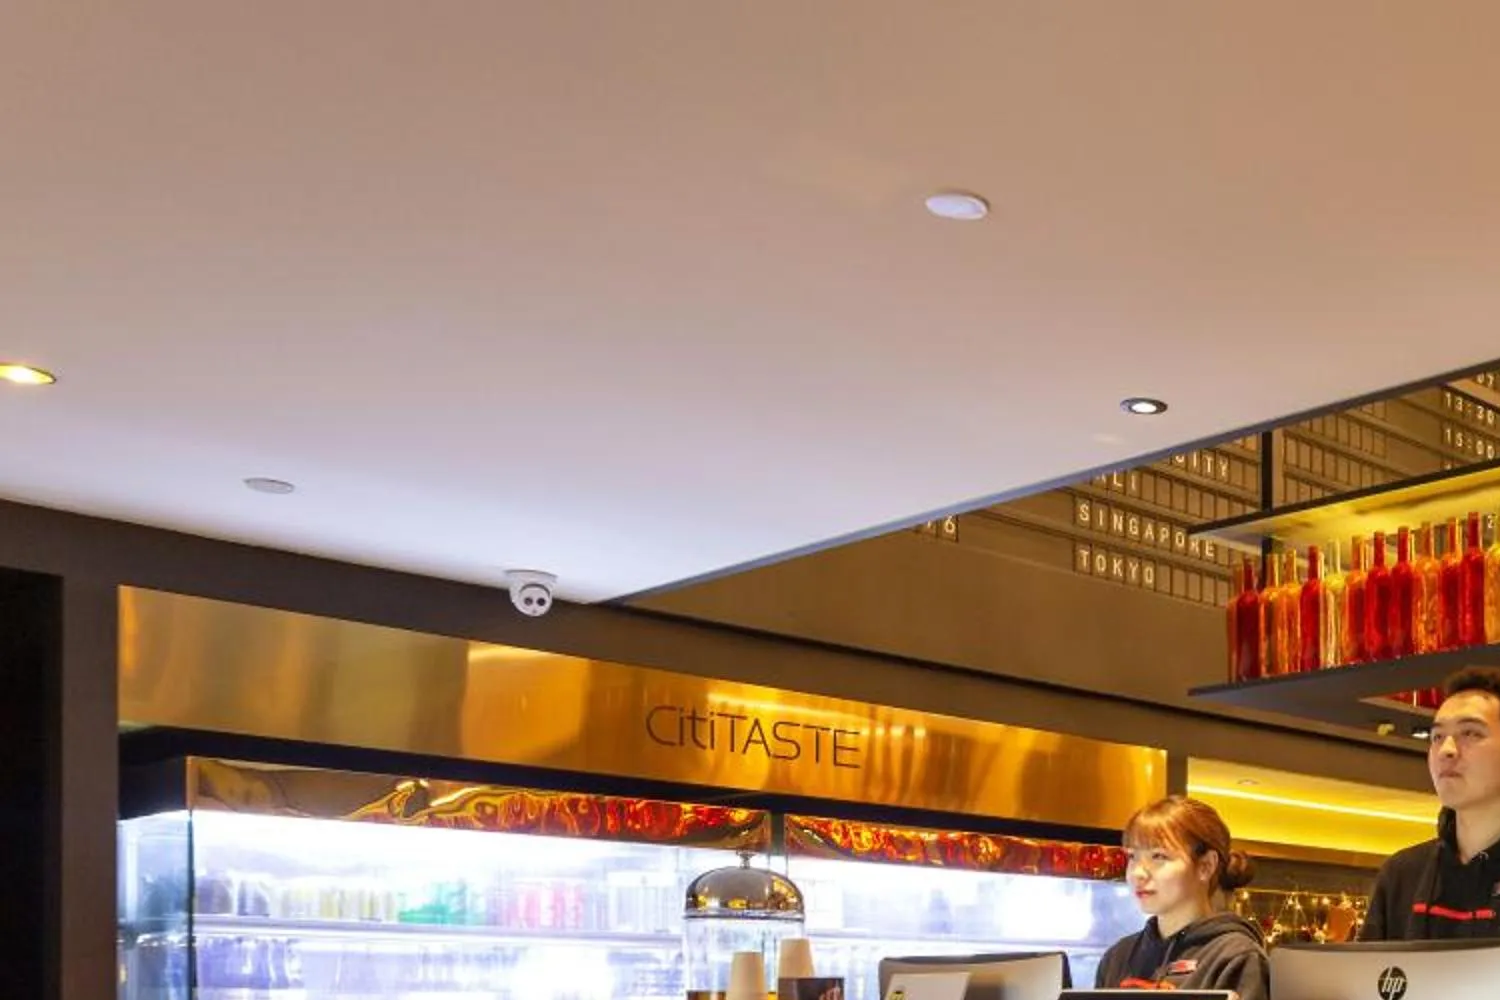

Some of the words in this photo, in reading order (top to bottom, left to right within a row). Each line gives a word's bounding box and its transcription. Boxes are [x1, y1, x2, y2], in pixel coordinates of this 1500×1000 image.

[1078, 500, 1216, 558] SINGAPORE
[1077, 549, 1155, 584] TOKYO
[646, 705, 861, 769] CitiTASTE
